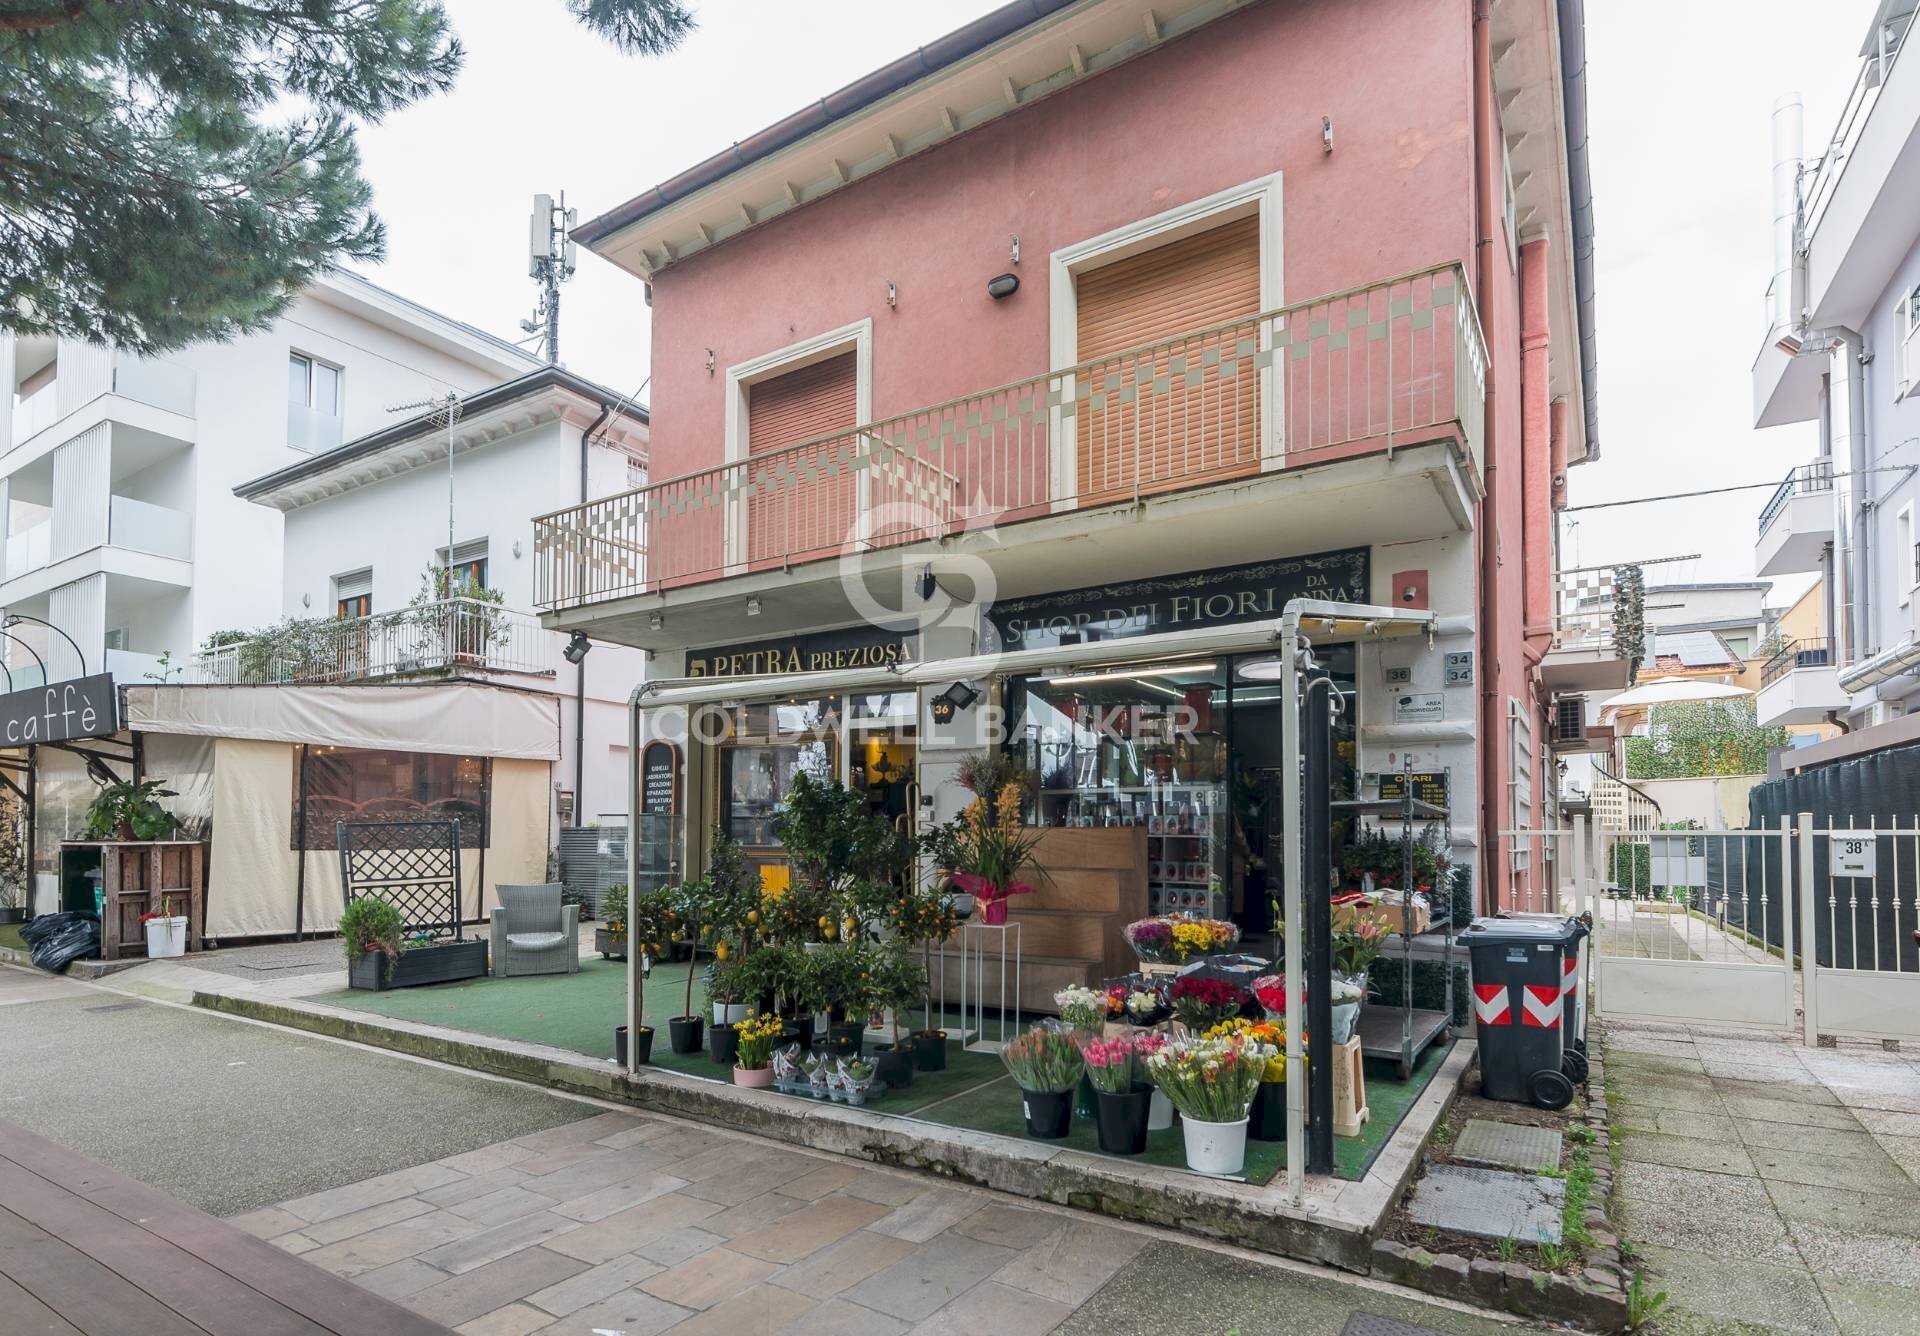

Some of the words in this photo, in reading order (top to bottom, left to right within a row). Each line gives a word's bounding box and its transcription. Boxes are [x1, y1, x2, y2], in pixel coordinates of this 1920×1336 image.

[1306, 573, 1328, 587] DA
[1103, 603, 1159, 630] DEI
[1168, 588, 1277, 624] FIORI
[713, 646, 805, 677] PETRA
[810, 642, 912, 670] PREZIOSA
[1450, 655, 1468, 665] 34
[1391, 670, 1407, 680] 36
[7, 684, 96, 742] caffè
[935, 704, 949, 714] 36
